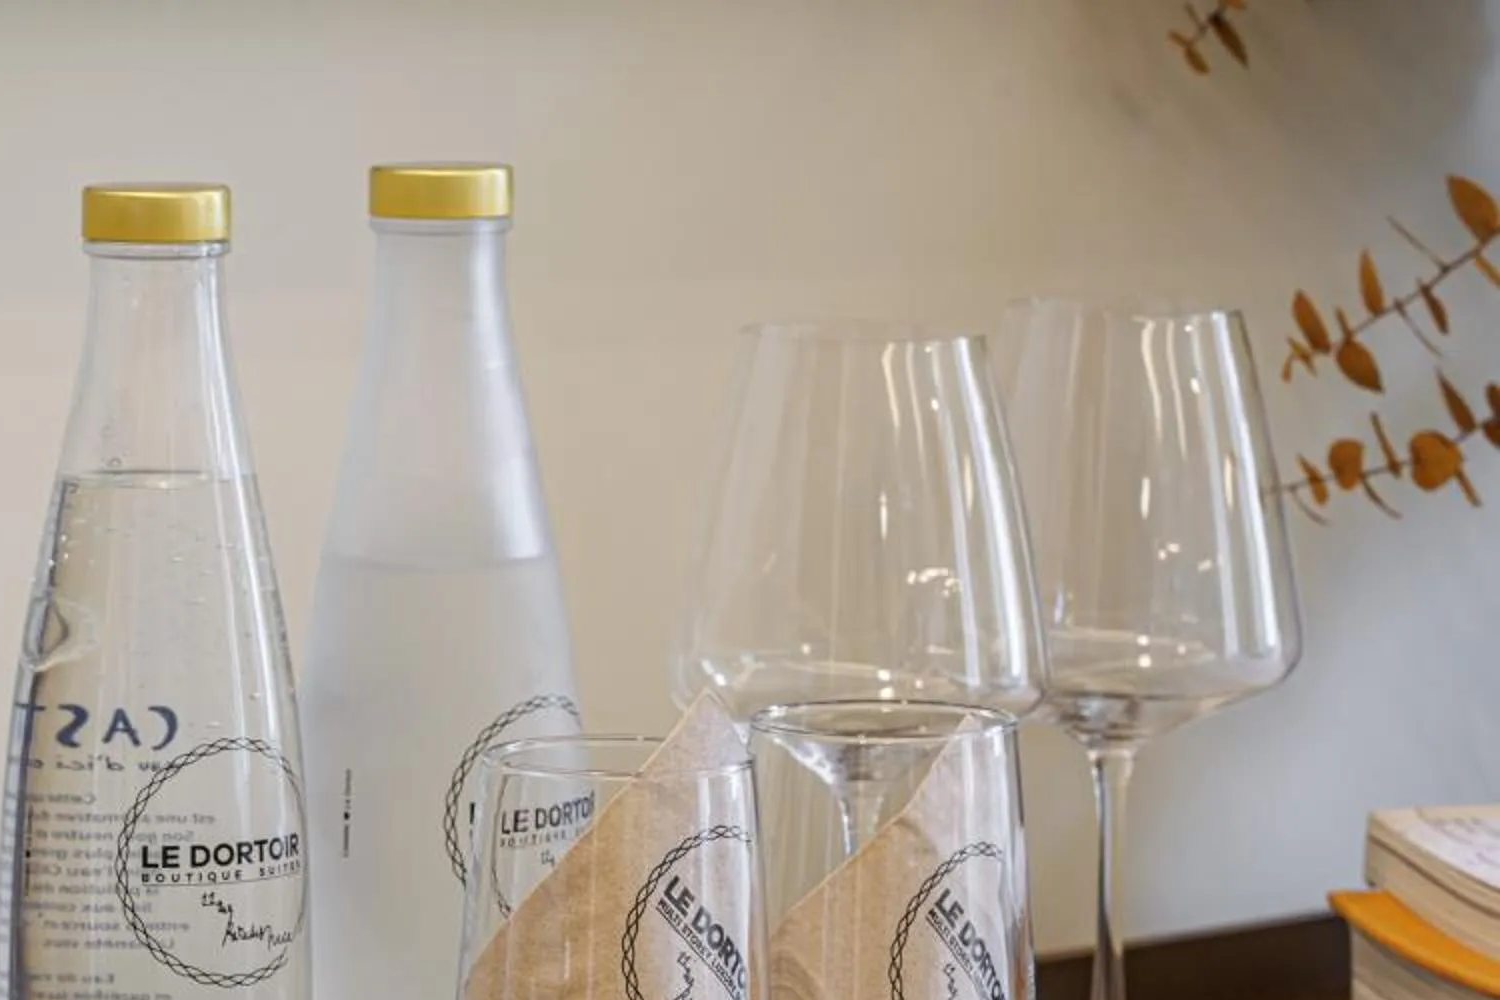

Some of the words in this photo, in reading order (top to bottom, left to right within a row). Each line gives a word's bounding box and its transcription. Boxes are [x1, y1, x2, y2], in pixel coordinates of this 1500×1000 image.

[501, 809, 529, 835] LE
[142, 845, 180, 869] LE
[190, 832, 299, 868] DORTOIR
[141, 869, 243, 884] BOUTIQUE
[935, 887, 964, 929] LE
[664, 875, 695, 918] LE
[692, 905, 746, 990] DORTO
